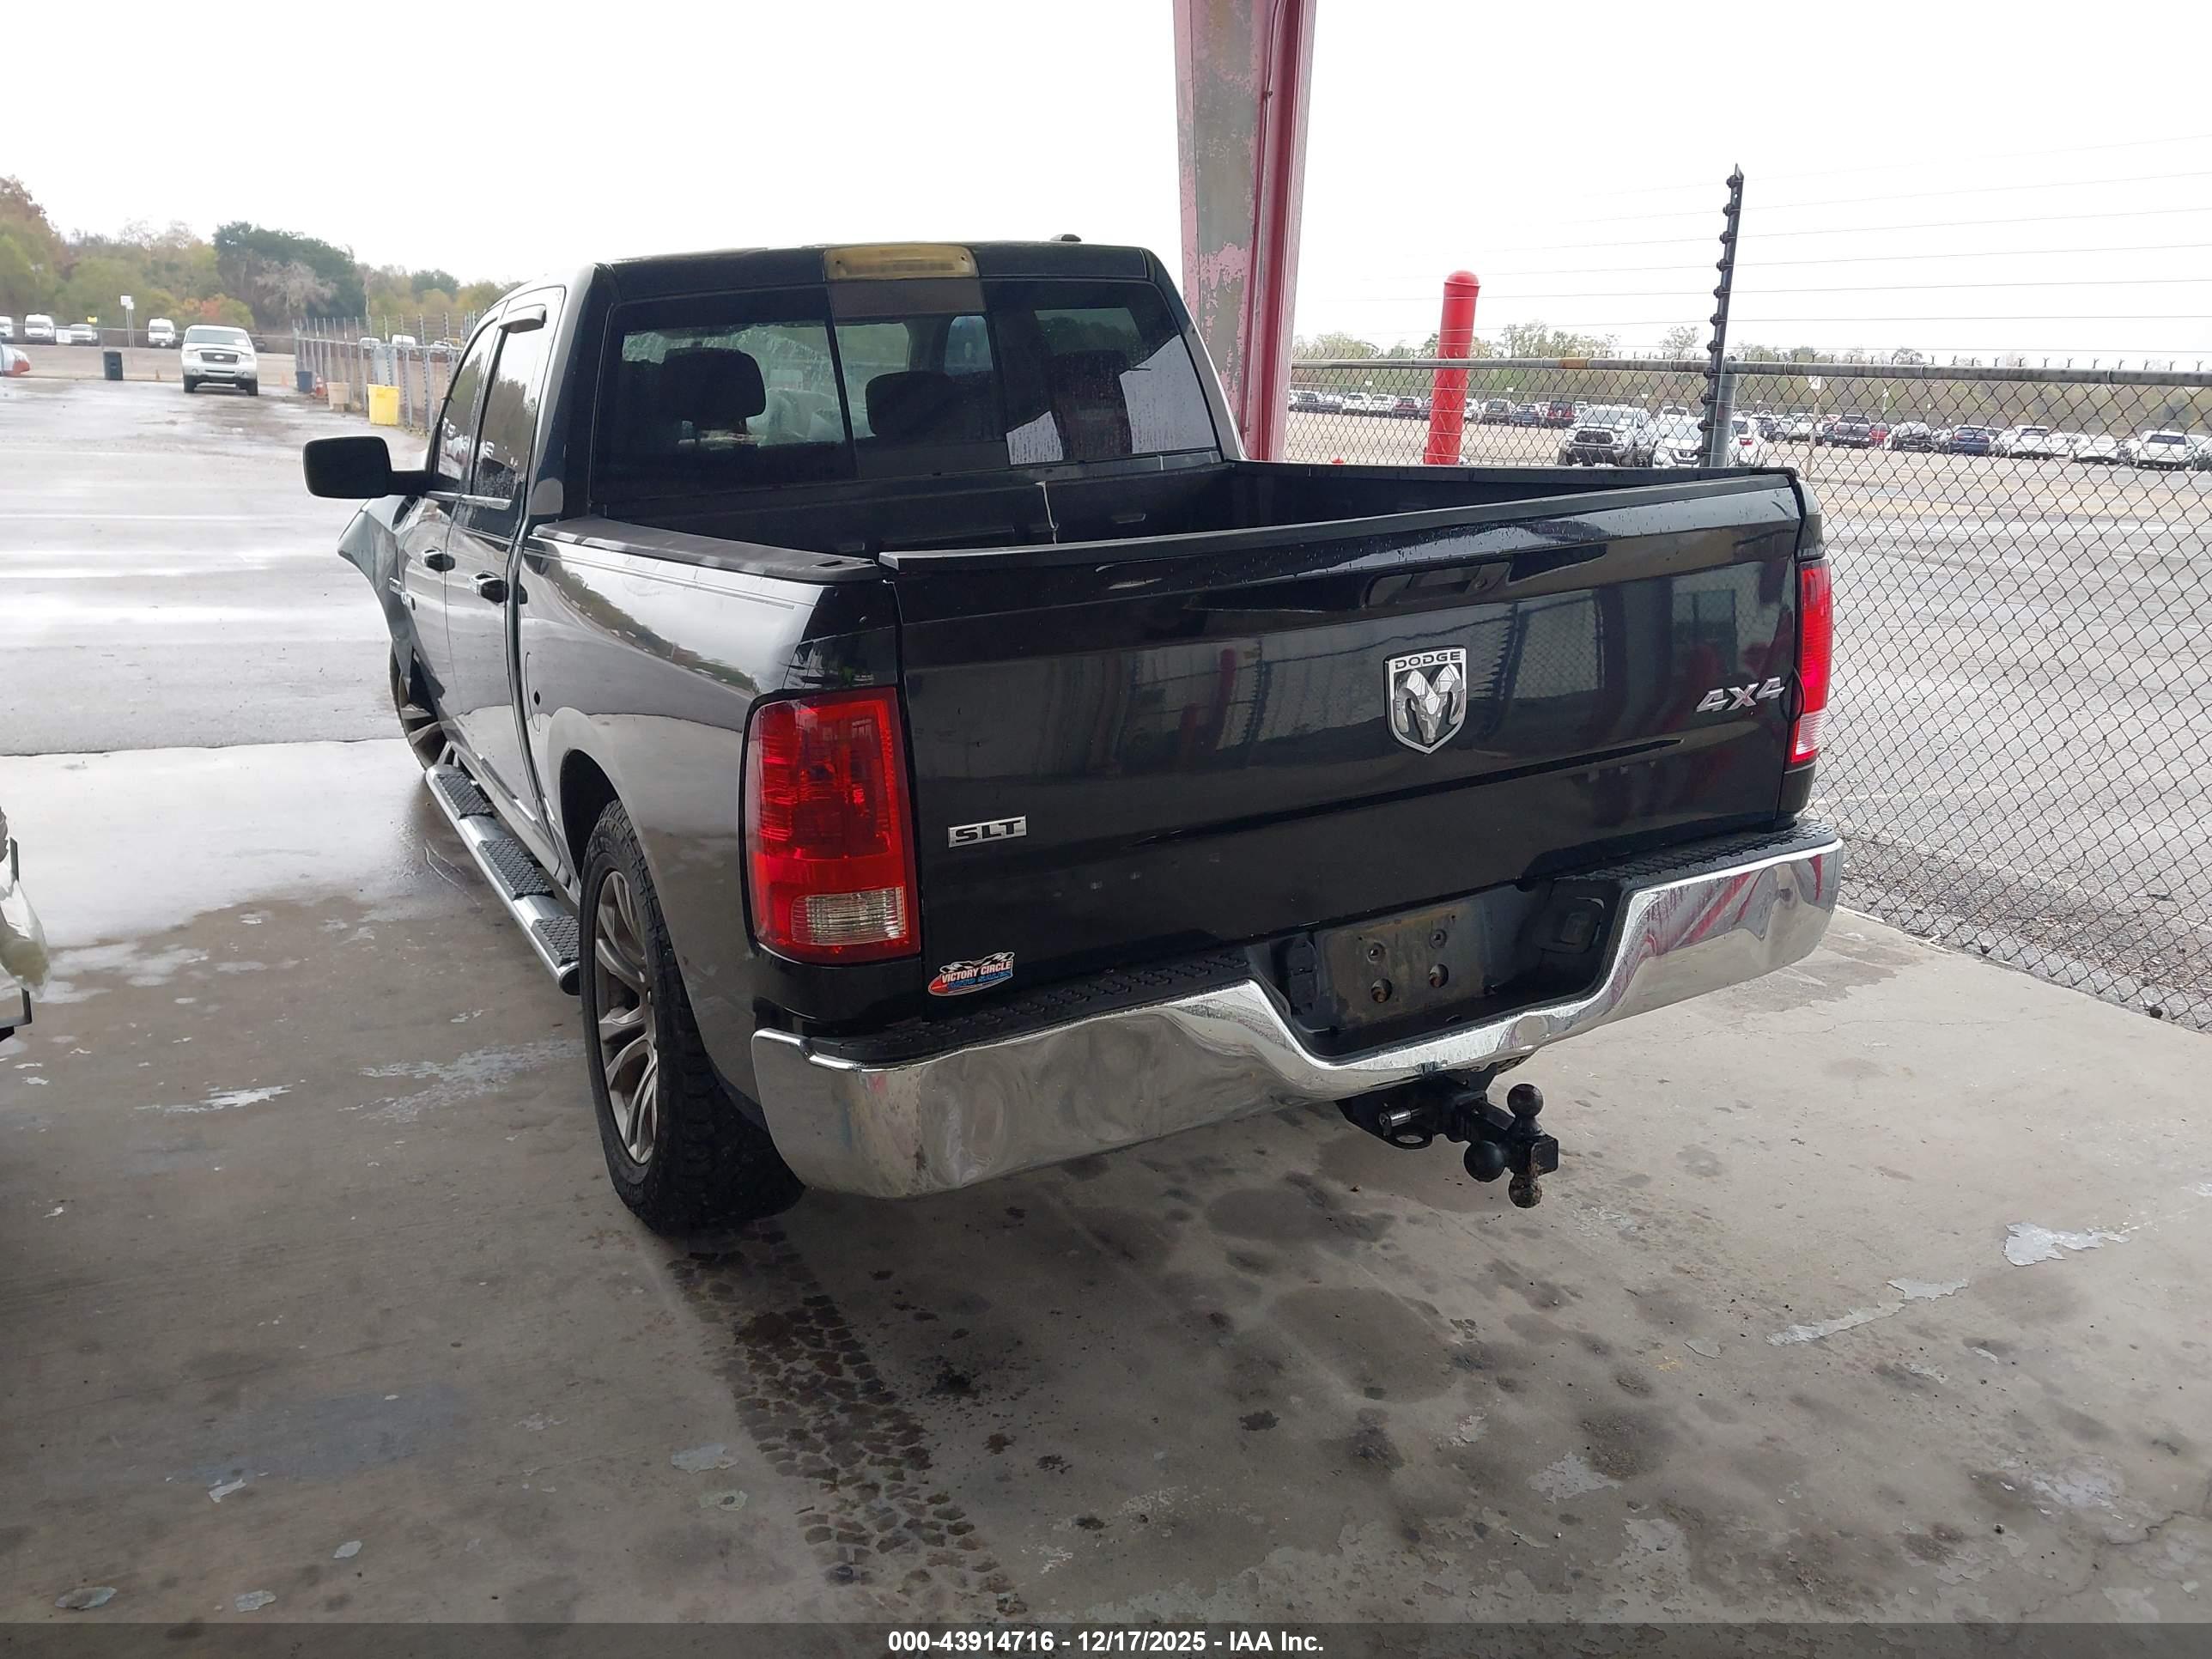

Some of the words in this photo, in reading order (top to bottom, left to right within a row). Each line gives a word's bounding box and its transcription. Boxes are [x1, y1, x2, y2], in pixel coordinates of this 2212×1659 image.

[1395, 651, 1462, 671] DODGE
[1696, 677, 1786, 713] 4X4
[955, 819, 1022, 843] SLT
[941, 967, 979, 983] VICTORY
[980, 961, 1012, 975] CIRCLE
